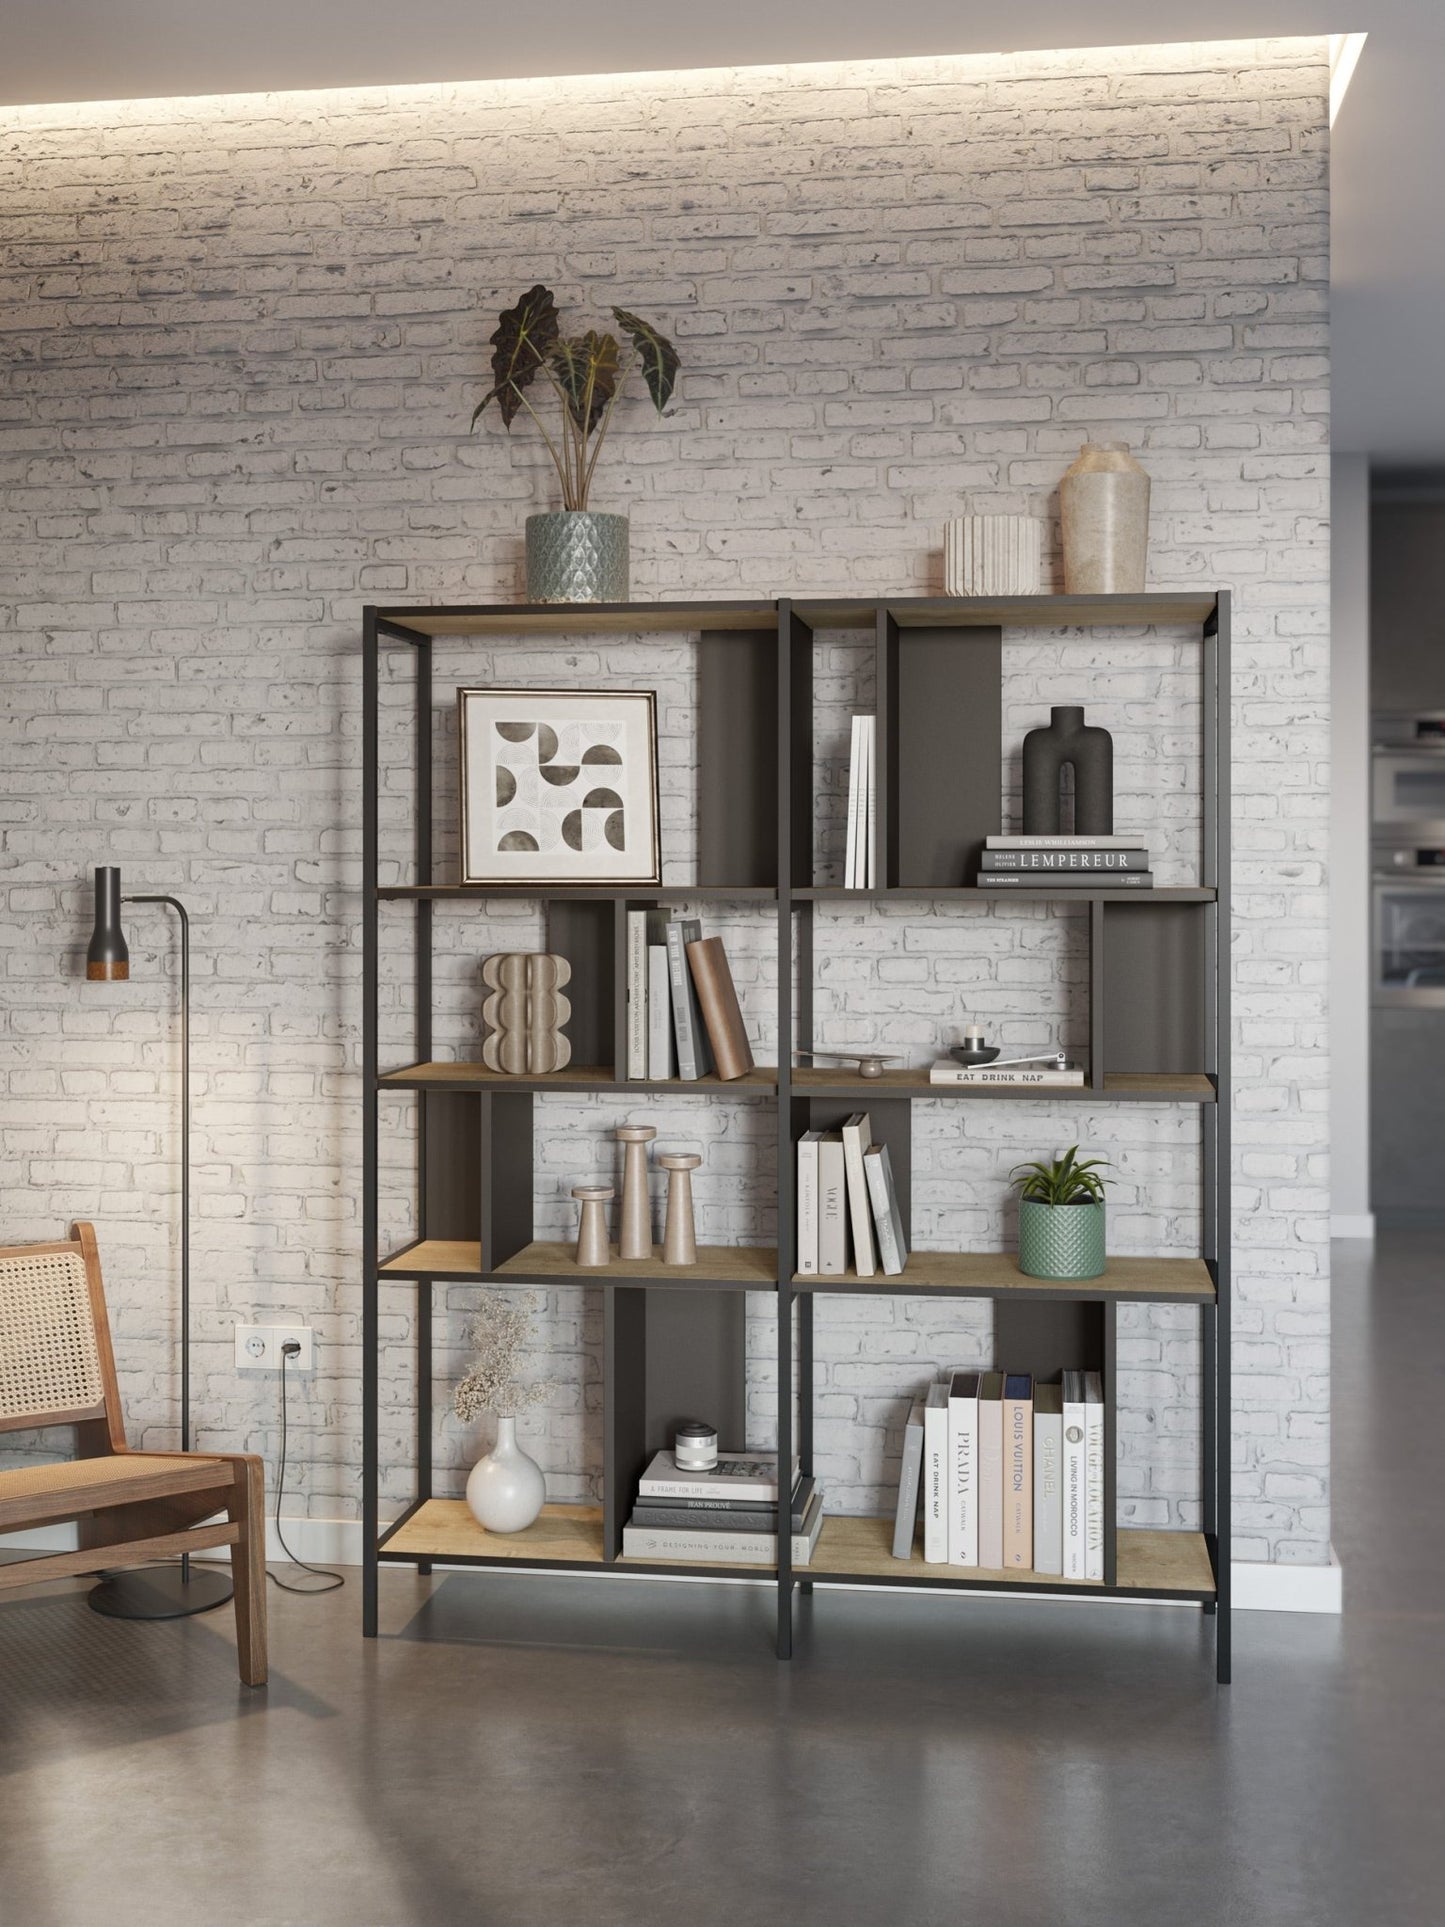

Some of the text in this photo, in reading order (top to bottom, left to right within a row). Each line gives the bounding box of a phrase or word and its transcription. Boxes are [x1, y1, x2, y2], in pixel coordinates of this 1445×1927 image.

[1020, 854, 1129, 867] LEMPEREUR
[956, 1073, 1044, 1082] EAT DRINK NAP
[957, 1432, 970, 1495] PRADA
[1013, 1406, 1023, 1492] LOUIS VUITTON
[1041, 1436, 1056, 1498] CHANEL
[657, 1486, 677, 1494] FRAME
[678, 1486, 690, 1494] FOR
[691, 1487, 703, 1495] LIFE
[1070, 1455, 1078, 1537] LIVING IN MOROCCO
[662, 1542, 771, 1553] DESIGNING YOUR WORLD
